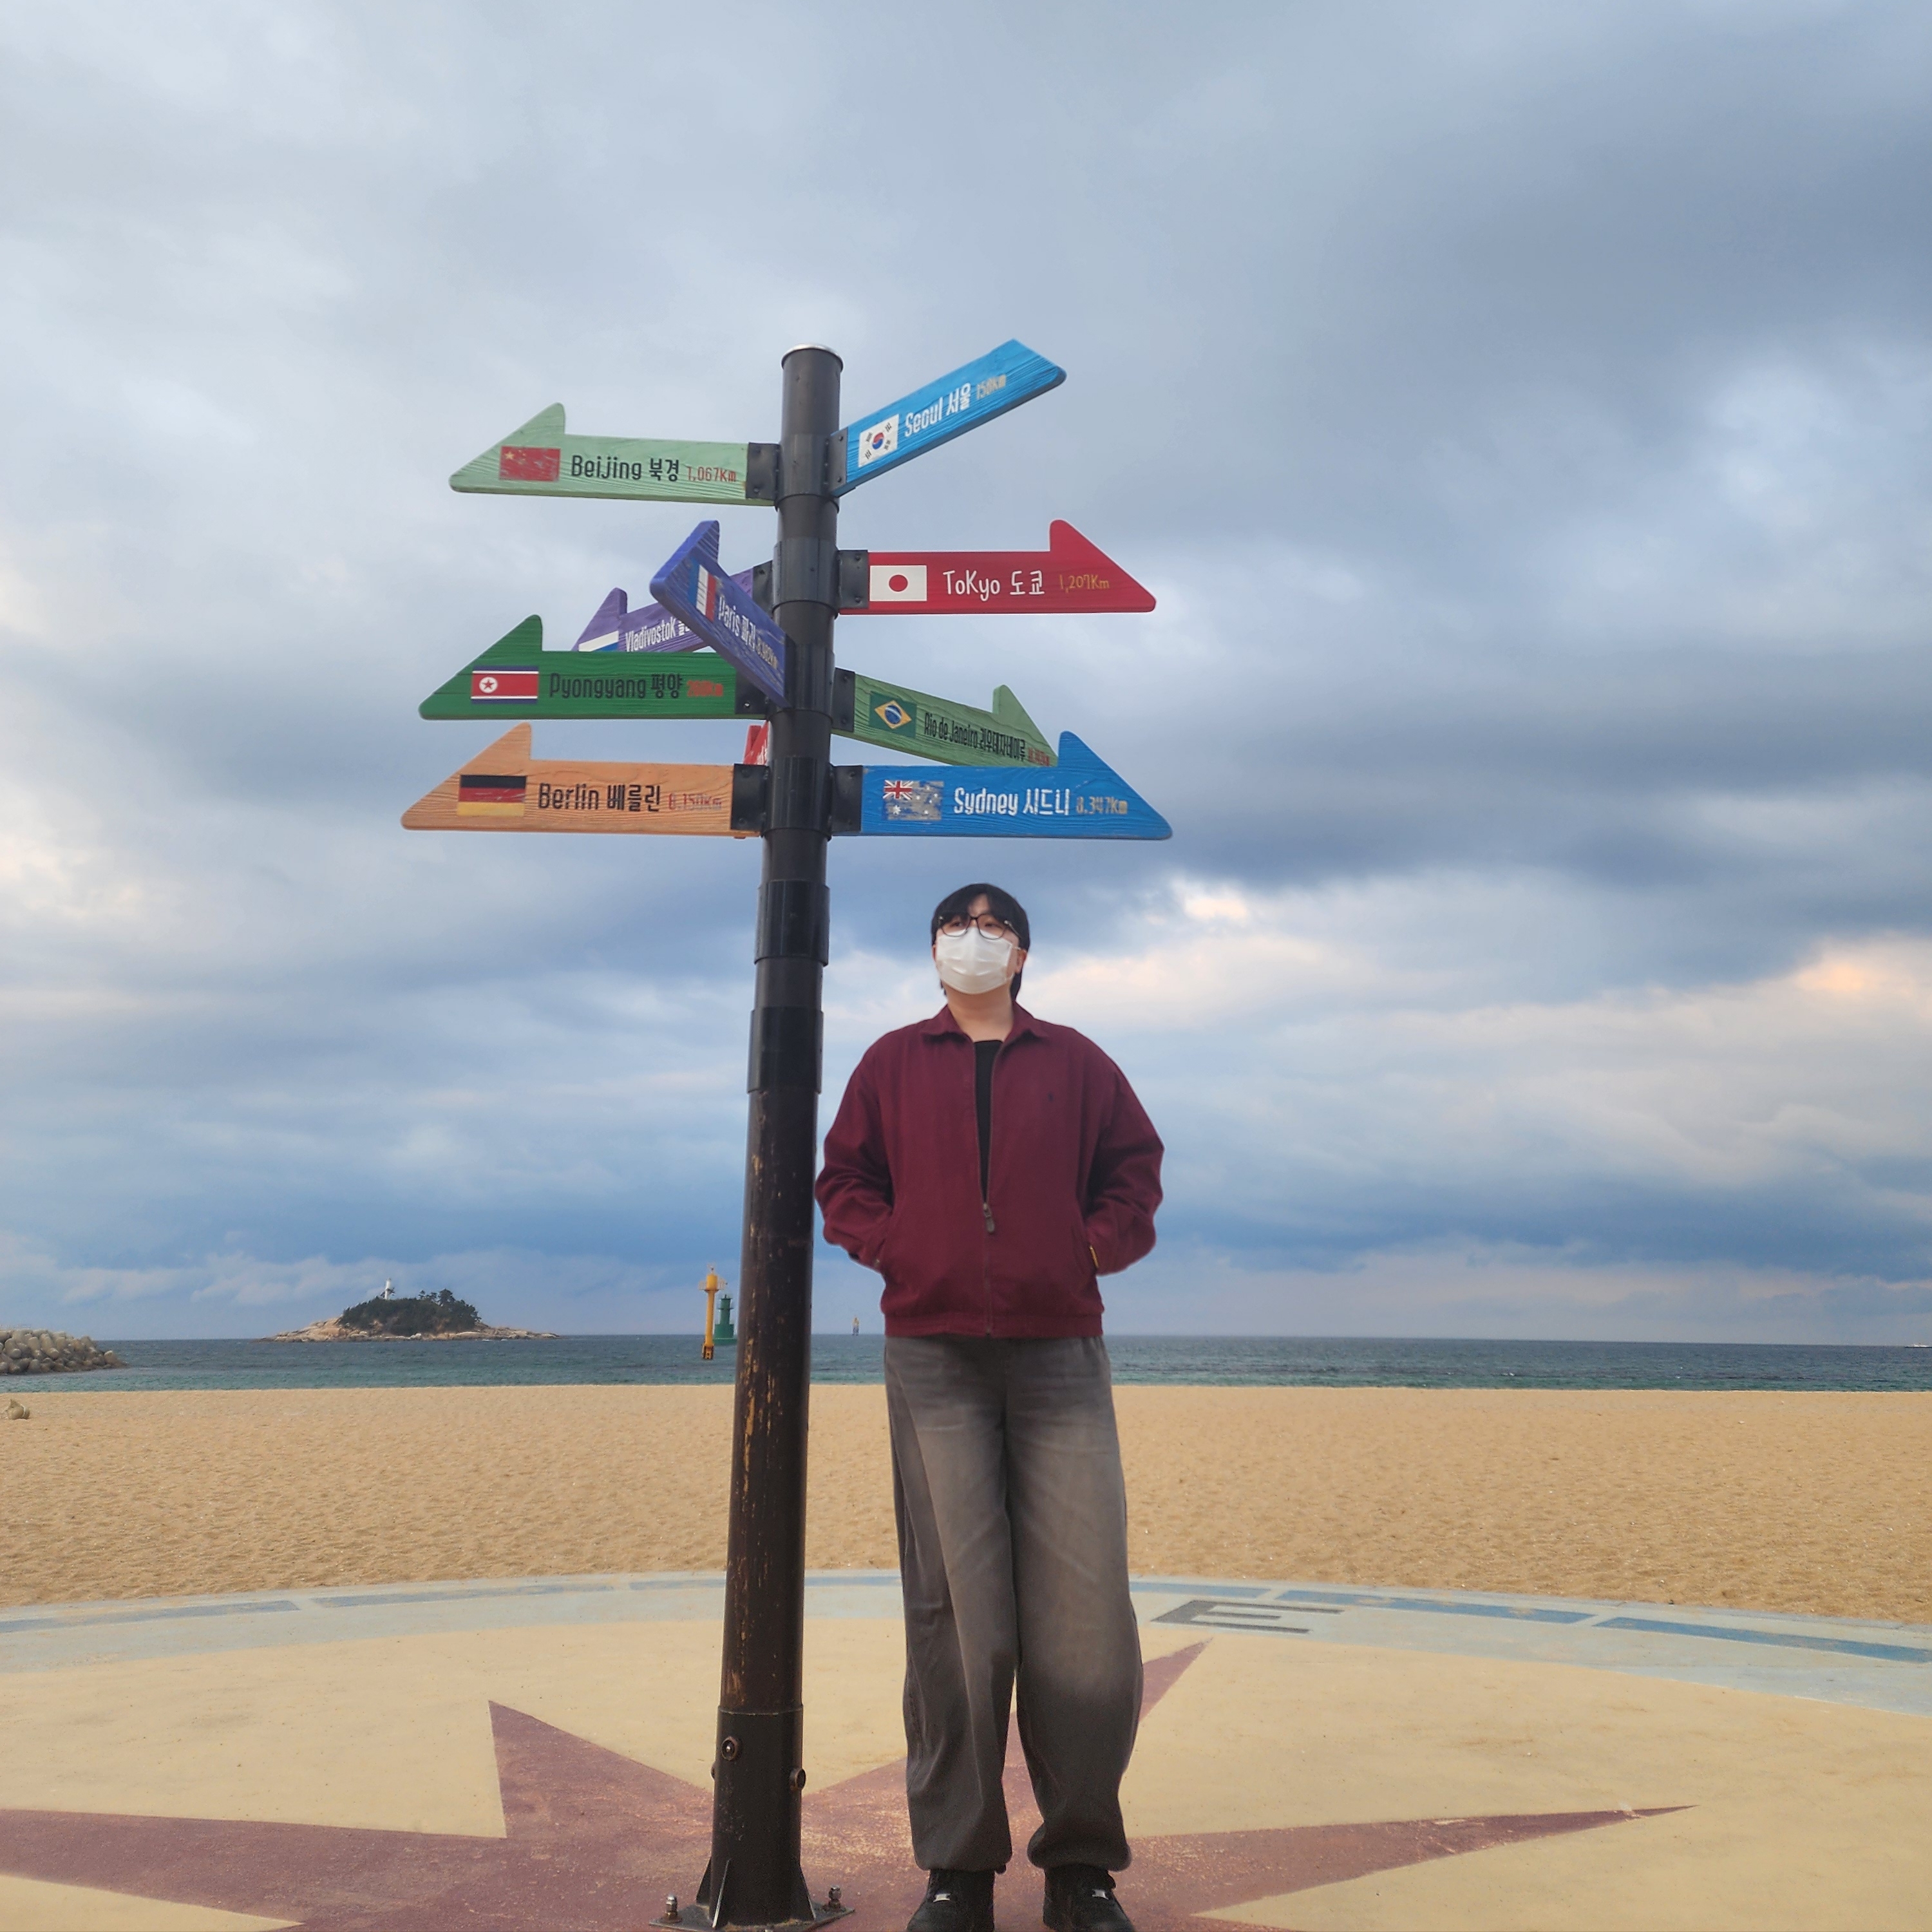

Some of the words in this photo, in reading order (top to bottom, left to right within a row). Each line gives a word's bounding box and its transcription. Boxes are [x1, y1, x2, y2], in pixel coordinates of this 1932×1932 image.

[905, 396, 943, 437] Seoul
[946, 383, 971, 416] 서울
[571, 455, 641, 480] Beijing
[649, 458, 679, 482] 북경
[1010, 570, 1045, 596] 도쿄
[718, 595, 741, 637] Paris
[741, 614, 756, 652] 파리
[549, 672, 645, 699] Pyongyang
[651, 673, 683, 699] 평양
[924, 712, 937, 737] Rio
[939, 717, 948, 741] de
[950, 721, 978, 749] Janeiro
[538, 783, 600, 810] Berlin
[607, 784, 660, 811] 베를린
[954, 787, 1018, 816] Sydney
[1023, 788, 1070, 816] 시드니
[1150, 1600, 1345, 1634] E
